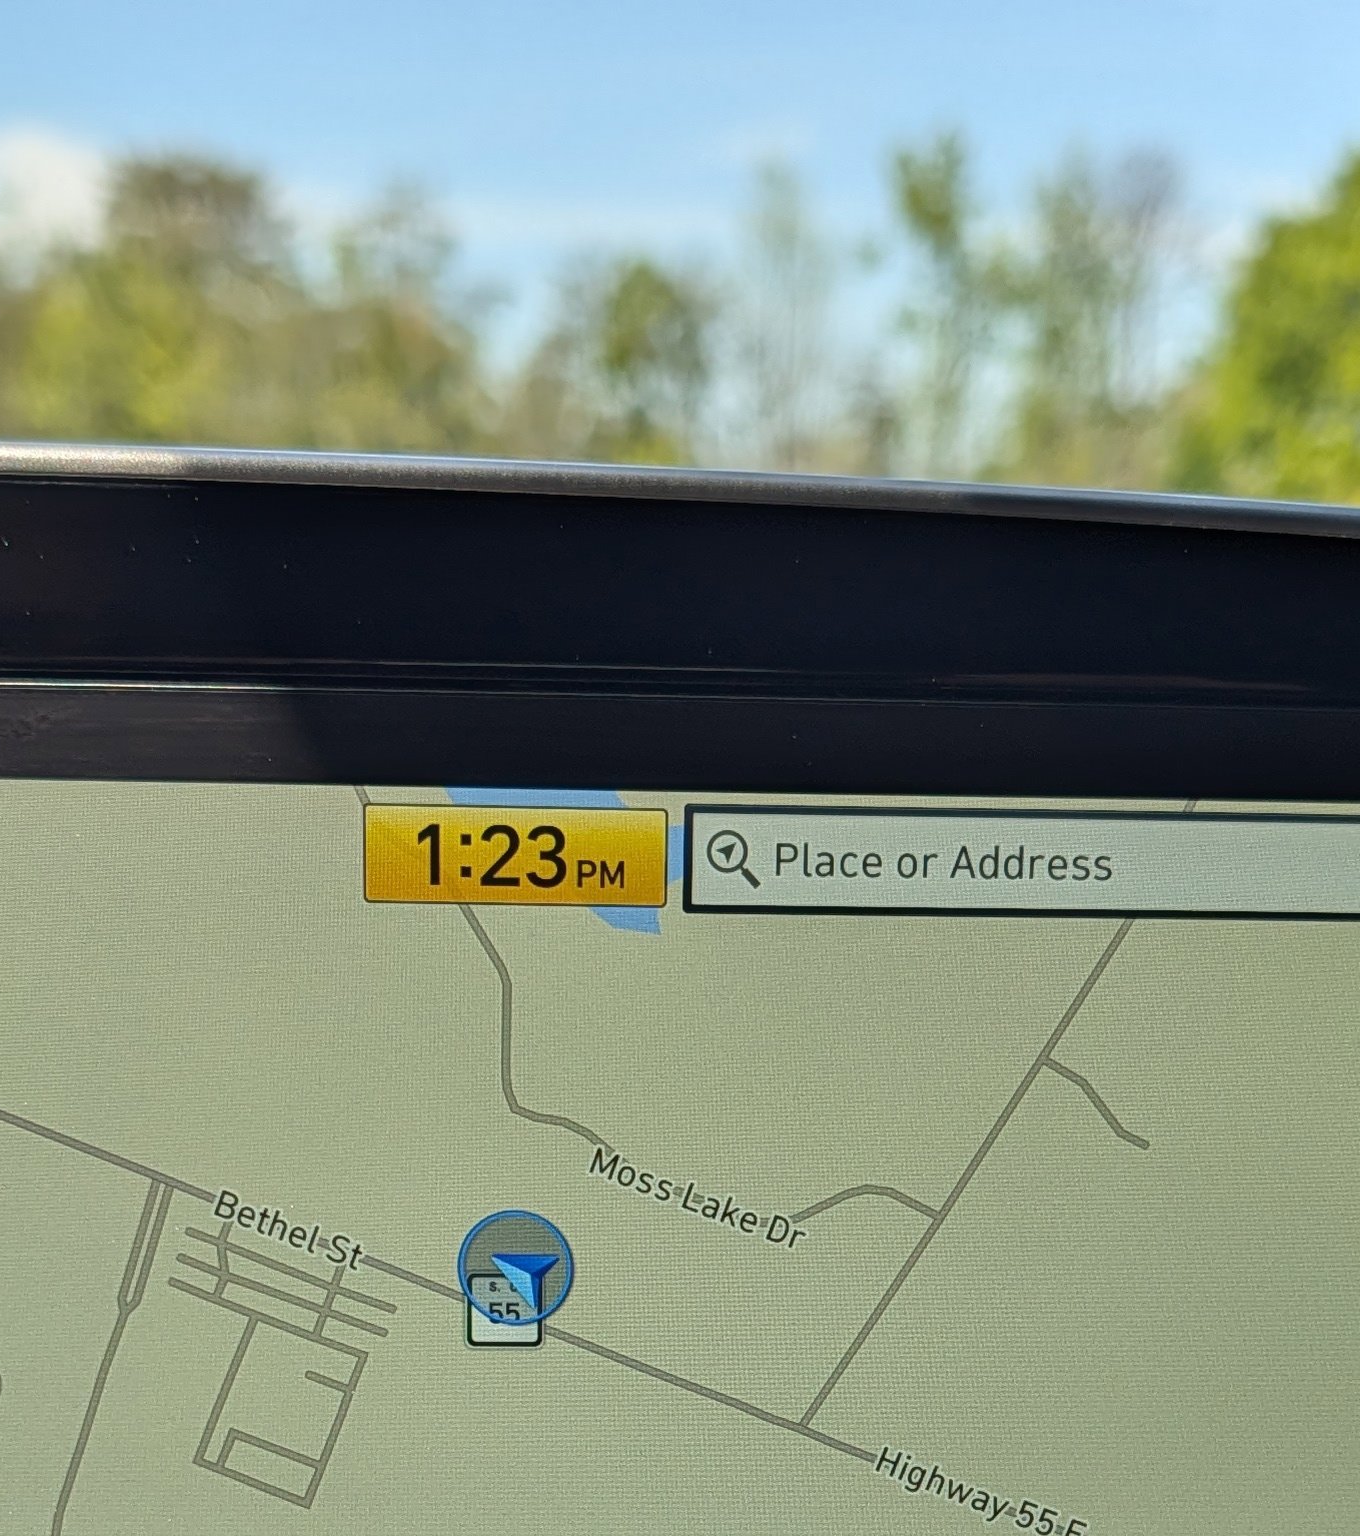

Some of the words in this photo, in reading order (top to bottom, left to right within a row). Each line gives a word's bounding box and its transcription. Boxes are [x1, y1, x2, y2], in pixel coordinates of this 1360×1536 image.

[416, 823, 568, 890] 1:23
[576, 861, 626, 890] PM
[774, 843, 883, 878] Place
[896, 852, 940, 879] or
[950, 845, 1114, 882] Address
[213, 1190, 320, 1254] Bethel
[325, 1235, 363, 1271] St
[589, 1147, 673, 1201] Moss
[681, 1182, 758, 1233] Lake
[765, 1215, 807, 1248] Dr
[488, 1302, 520, 1324] 55
[875, 1446, 1009, 1522] Highway
[1014, 1500, 1058, 1536] 55
